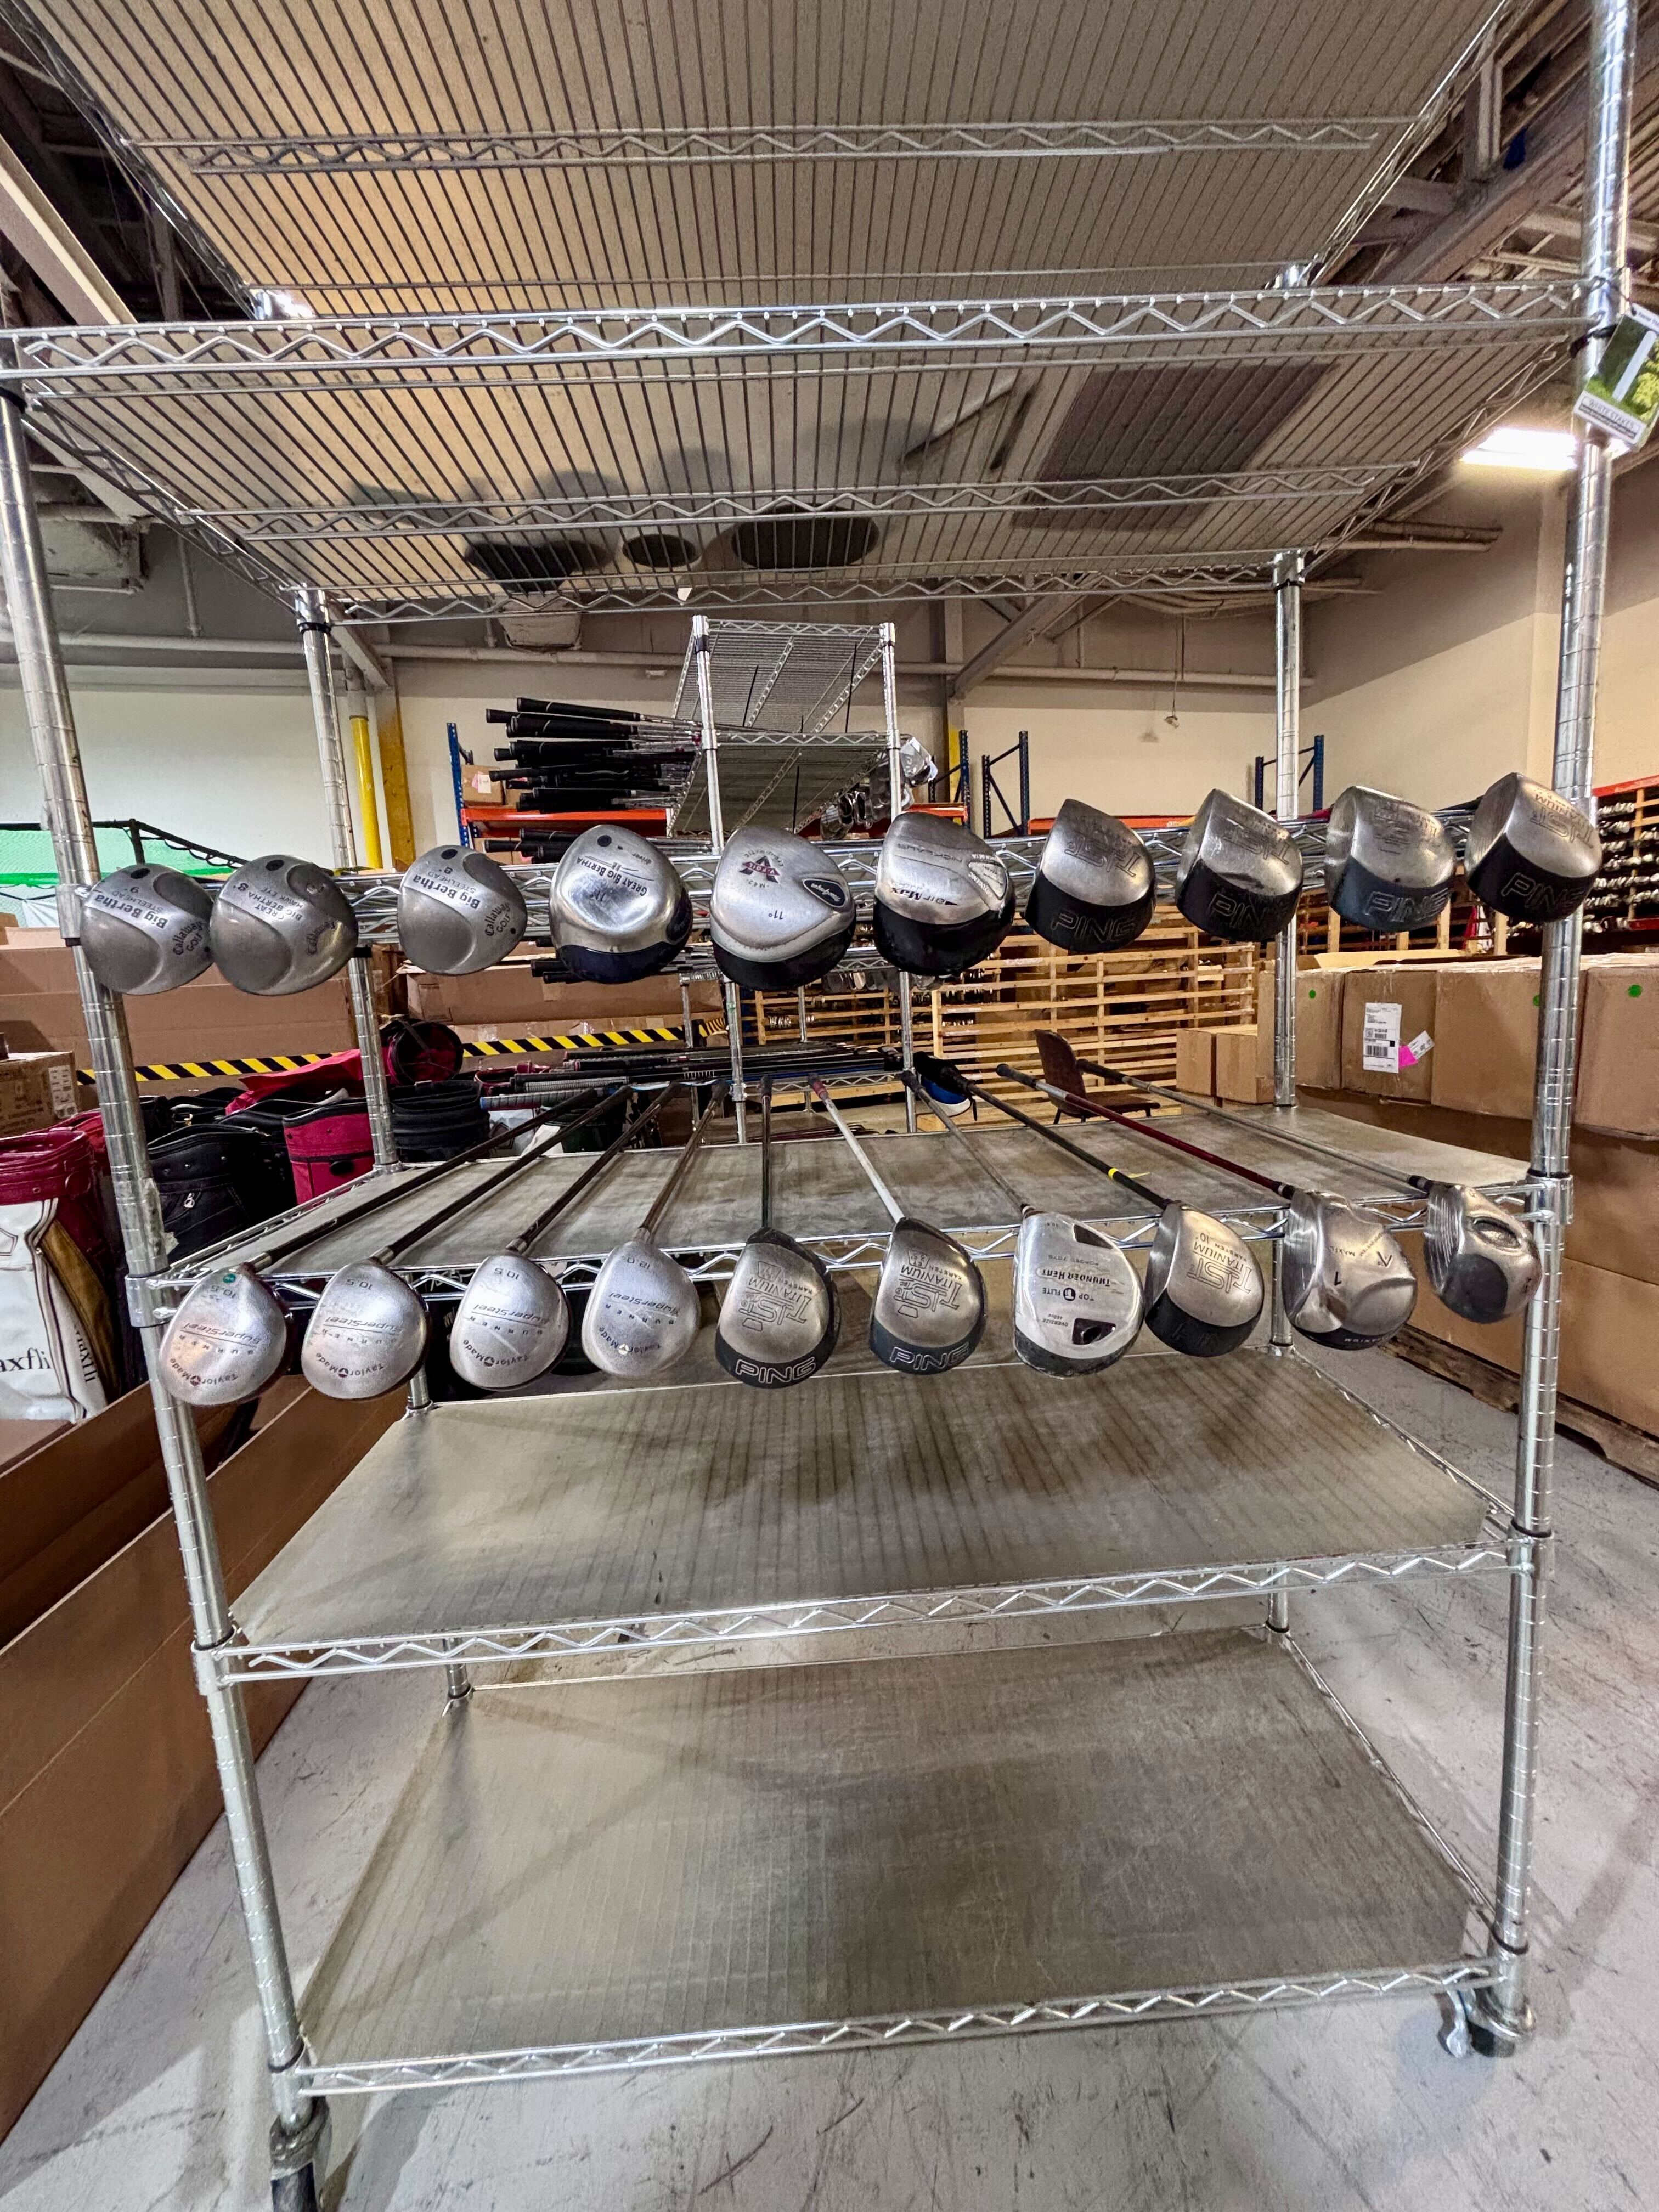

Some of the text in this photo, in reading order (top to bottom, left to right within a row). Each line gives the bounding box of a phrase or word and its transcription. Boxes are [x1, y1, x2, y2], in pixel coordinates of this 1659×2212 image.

[428, 871, 476, 894] STEELHEAD
[577, 856, 648, 897] GREAT BIG BERTHA
[111, 890, 164, 913] STEELHEAD
[248, 891, 284, 911] BERTHA
[412, 874, 481, 910] Big Bertha
[95, 894, 169, 929] Big Bertha
[484, 901, 510, 936] Callaway
[496, 913, 511, 933] GOLF
[172, 921, 204, 956] Callaway
[1050, 909, 1135, 943] PING
[901, 1264, 963, 1299] TITANIUM
[1042, 1287, 1061, 1296] FLITE
[1066, 1272, 1111, 1287] THUNDER
[1078, 1293, 1095, 1301] TOP
[1042, 1317, 1069, 1327] OVERSIZE
[736, 1356, 816, 1384] PING
[889, 1342, 969, 1372] PING
